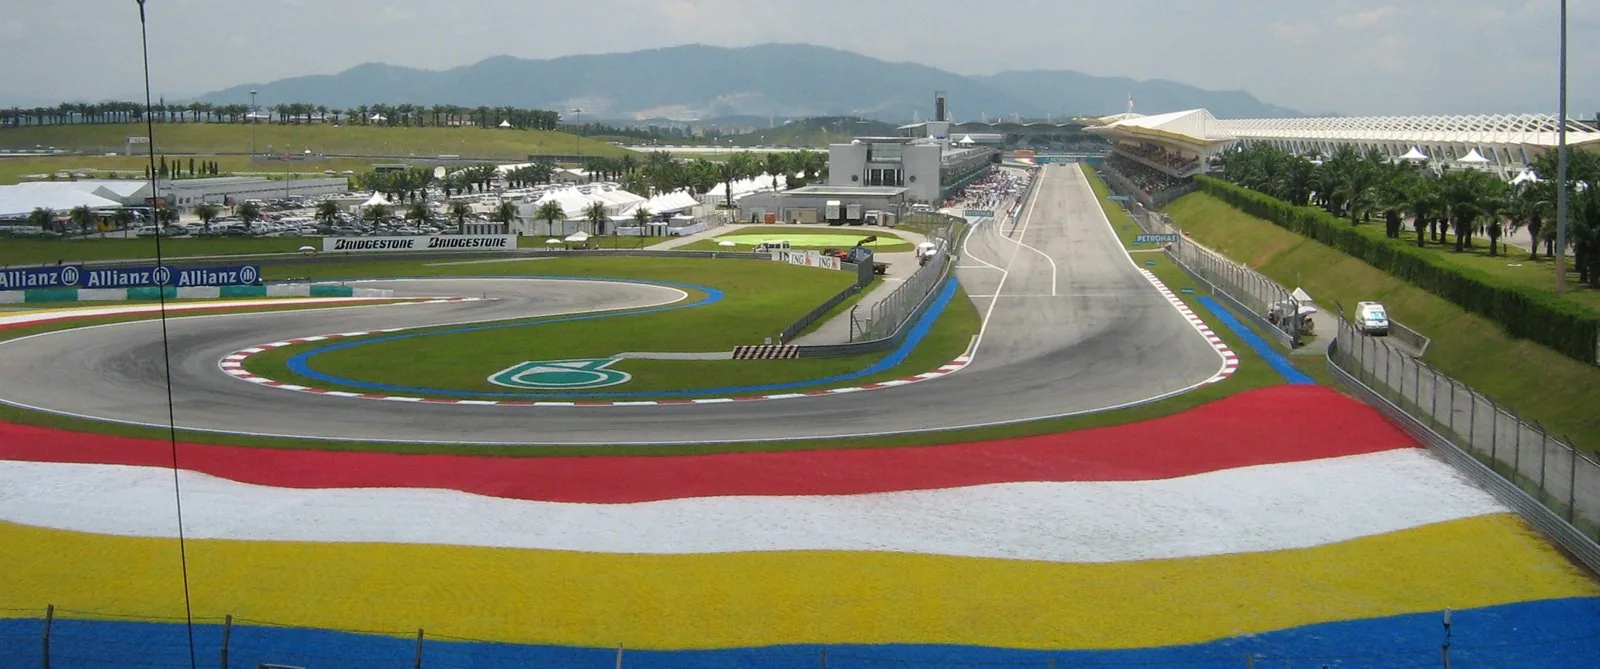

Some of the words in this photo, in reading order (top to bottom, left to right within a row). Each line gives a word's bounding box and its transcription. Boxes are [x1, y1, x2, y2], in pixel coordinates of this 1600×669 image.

[334, 239, 414, 250] BRIDGESTONE
[427, 237, 507, 248] BRIDGESTONE
[791, 254, 804, 265] ING
[0, 271, 58, 287] Allianz
[88, 270, 149, 286] Allianz
[179, 270, 237, 286] Allianz
